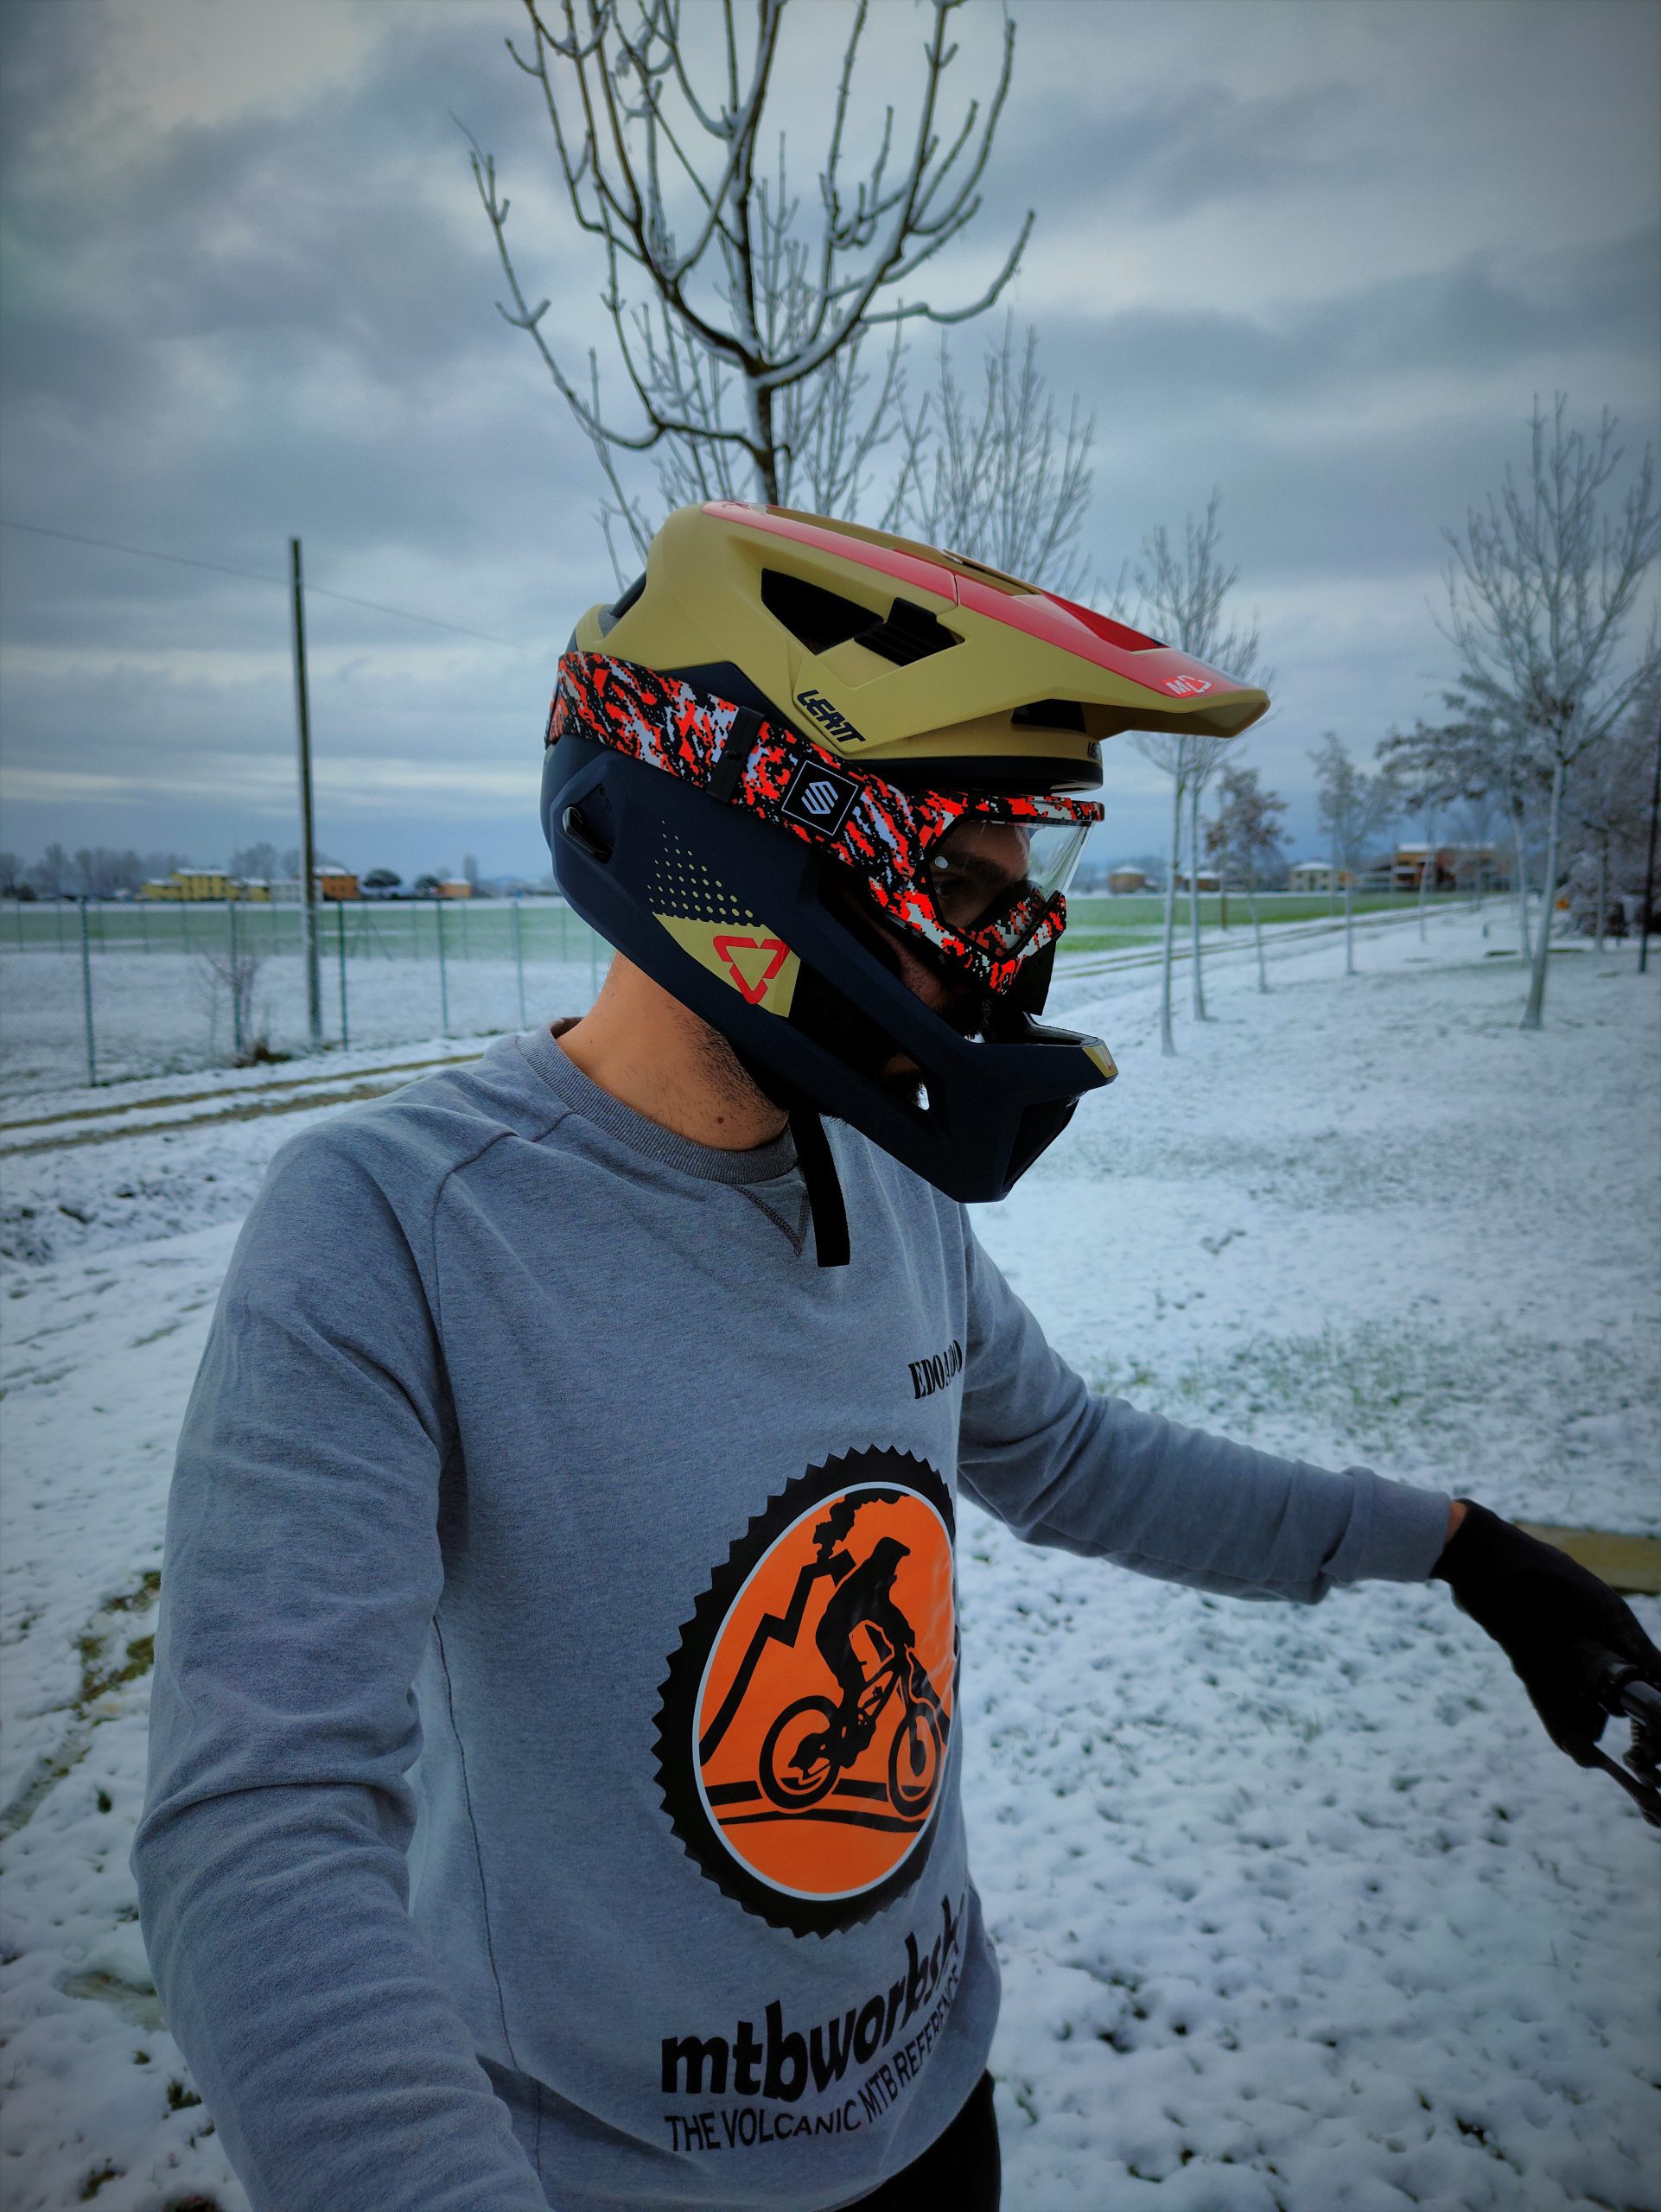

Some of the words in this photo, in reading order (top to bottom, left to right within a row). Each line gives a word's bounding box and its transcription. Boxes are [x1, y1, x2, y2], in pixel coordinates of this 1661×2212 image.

[797, 690, 866, 742] LEATT
[665, 2111, 721, 2152] THE
[722, 2100, 861, 2148] VOLCANIC
[857, 2063, 898, 2124] MTB
